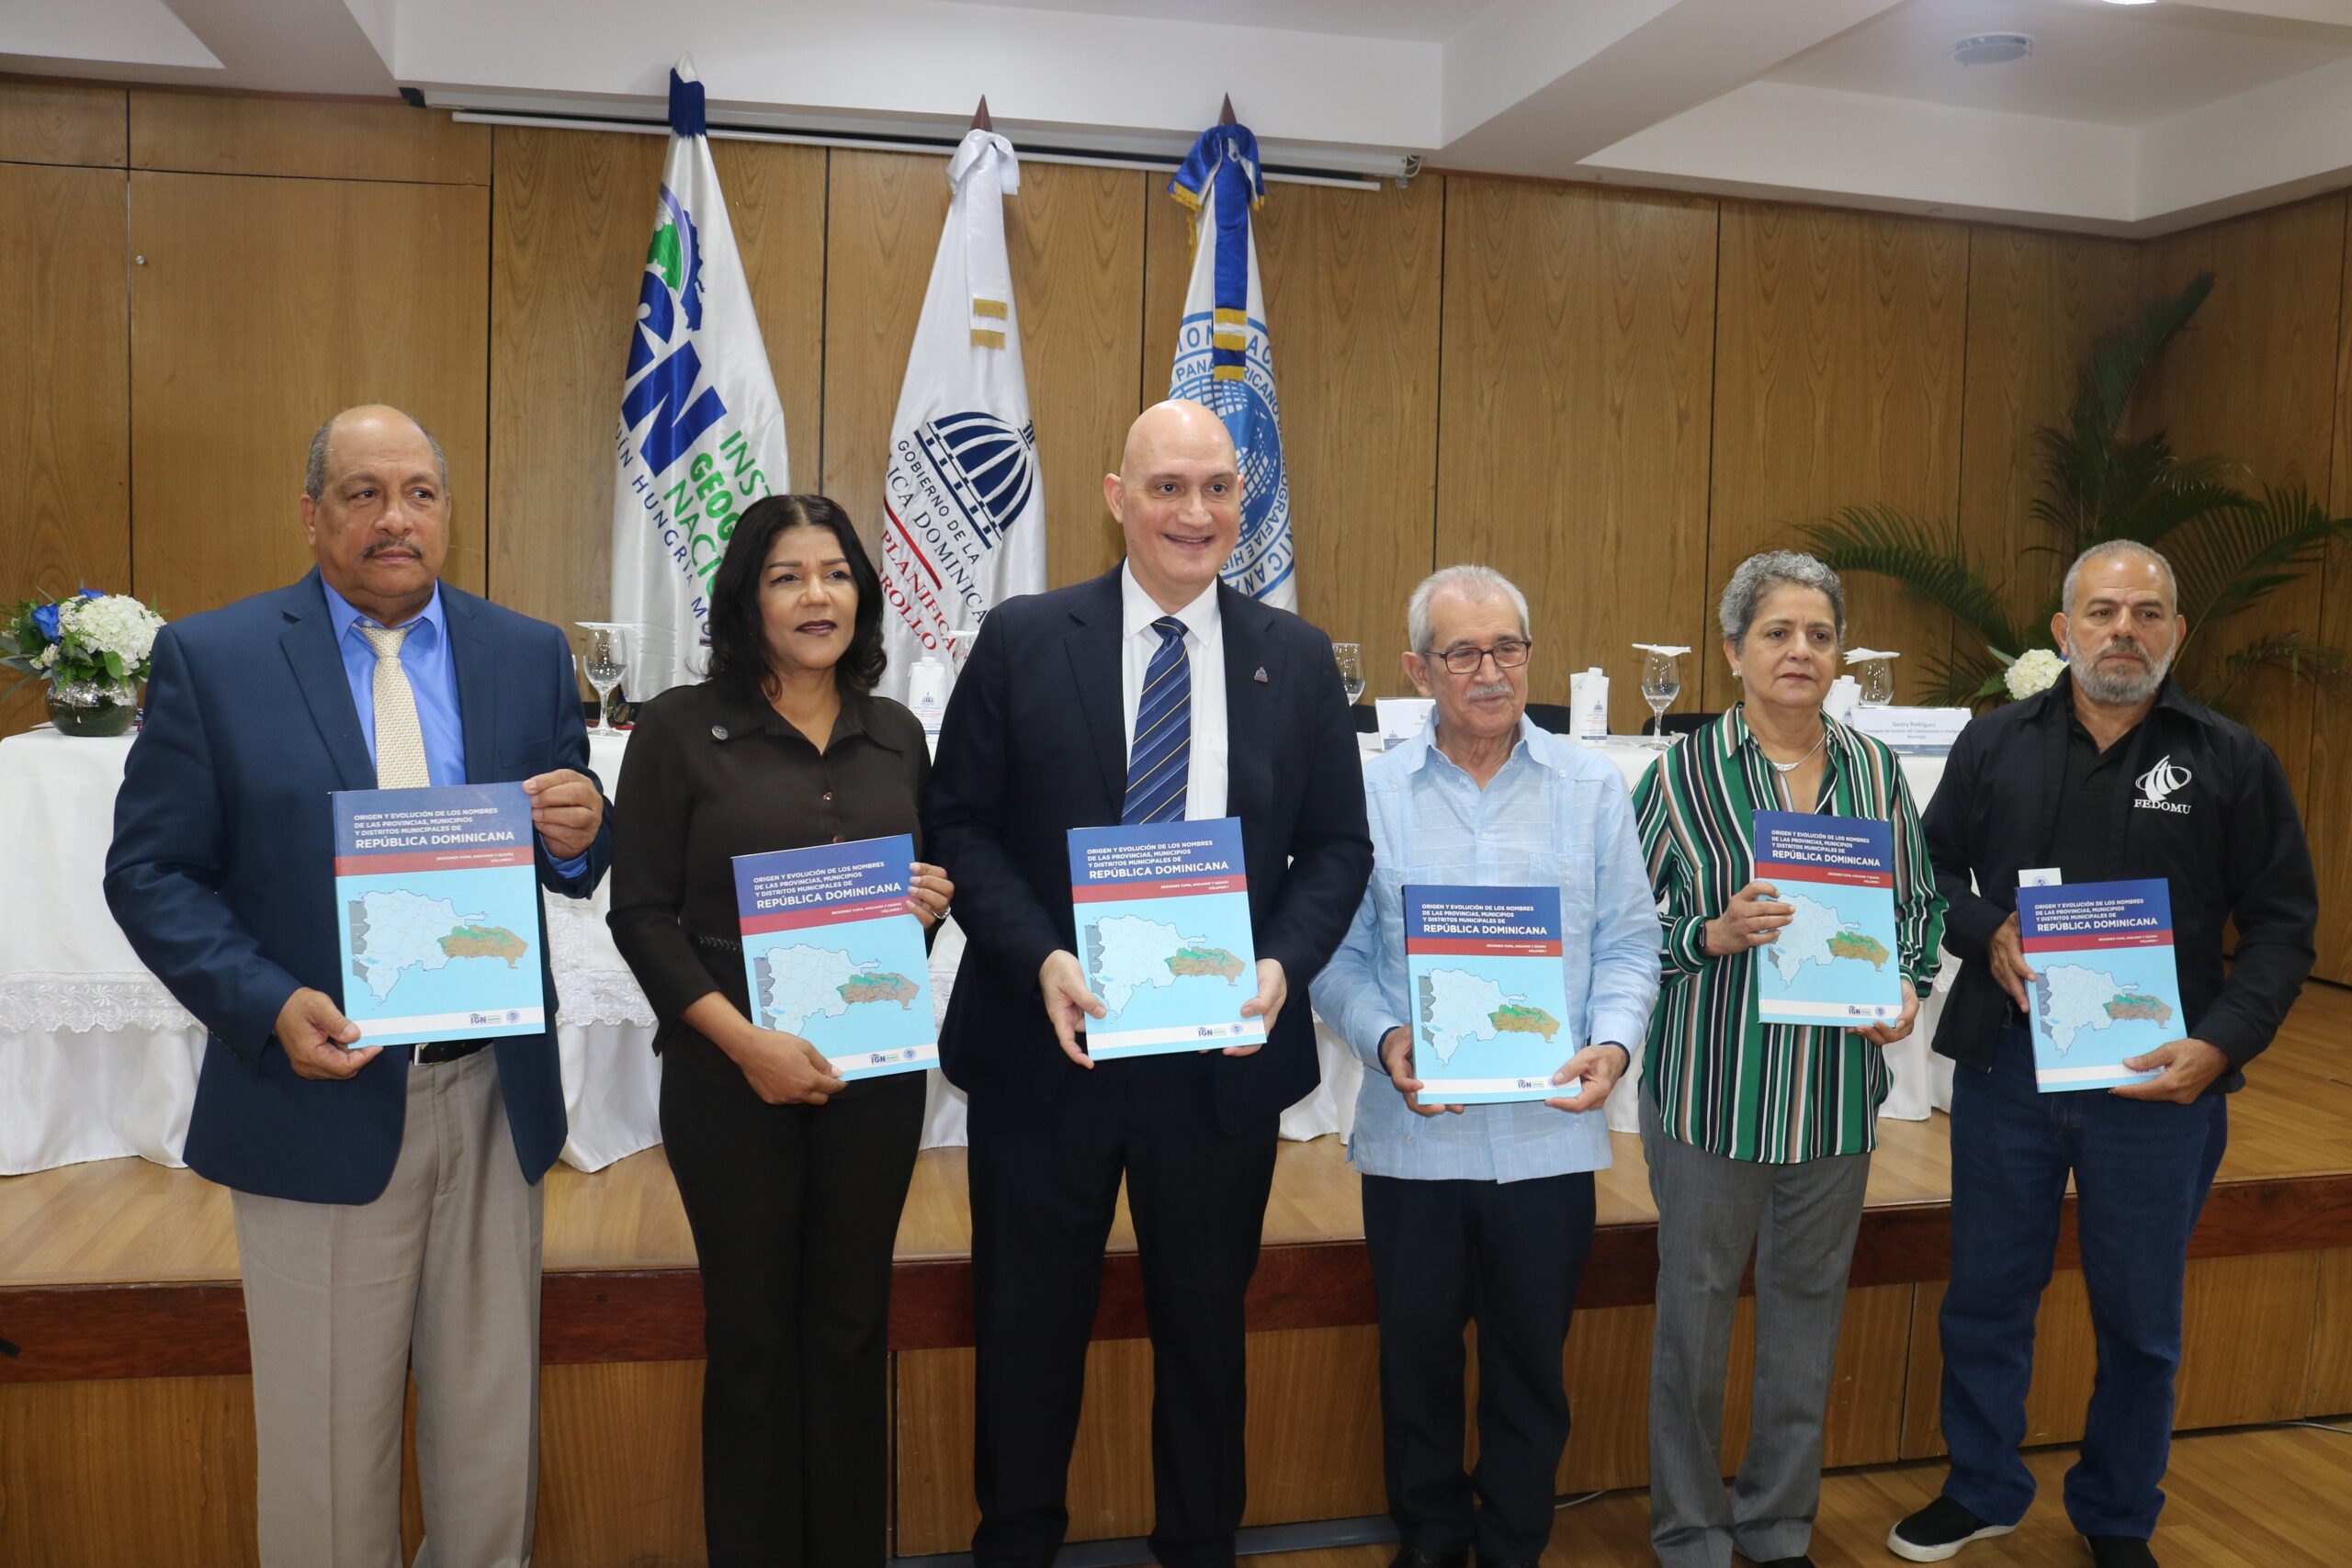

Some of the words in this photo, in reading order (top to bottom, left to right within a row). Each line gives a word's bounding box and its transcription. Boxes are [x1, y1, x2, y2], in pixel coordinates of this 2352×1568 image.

[1176, 358, 1280, 415] PANARICANO
[898, 440, 949, 517] GOBIERNO
[947, 520, 967, 541] DE
[962, 543, 980, 565] LA
[888, 466, 914, 509] ICA
[913, 511, 989, 626] DOMINICA
[882, 529, 956, 660] PLANIFICA
[881, 573, 937, 650] ROLLO
[390, 810, 434, 819] EVOLUCIÓN
[2133, 798, 2192, 815] FEDOMU
[356, 836, 427, 849] REPÚBLICA
[432, 832, 514, 845] DOMINICANA
[1797, 832, 1826, 840] EVOLUCIÓN
[1119, 843, 1157, 852] EVOLUCIÓN
[1154, 849, 1191, 857] MUNICIPIOS
[1804, 845, 1838, 853] MUNICIPALES
[1094, 860, 1127, 868] DISTRITOS
[1128, 857, 1171, 865] MUNICIPALES
[1772, 850, 1823, 863] REPÚBLICA
[1825, 854, 1881, 867] DOMINICANA
[753, 874, 780, 883] ORIGEN
[786, 868, 826, 879] EVOLUCIÓN
[853, 862, 885, 871] NOMBRES
[823, 873, 863, 883] MUNICIPIOS
[1090, 866, 1152, 879] REPÚBLICA
[1156, 862, 1228, 874] DOMINICANA
[757, 893, 822, 909] REPÚBLICA
[825, 883, 901, 900] DOMINICANA
[761, 887, 796, 897] DISTRITOS
[797, 882, 842, 893] MUNICIPALES
[2062, 900, 2095, 908] EVOLUCIÓN
[1424, 923, 1479, 934] REPÚBLICA
[1483, 926, 1547, 935] DOMINICANA
[2038, 921, 2091, 932] REPÚBLICA
[2094, 918, 2157, 930] DOMINICANA
